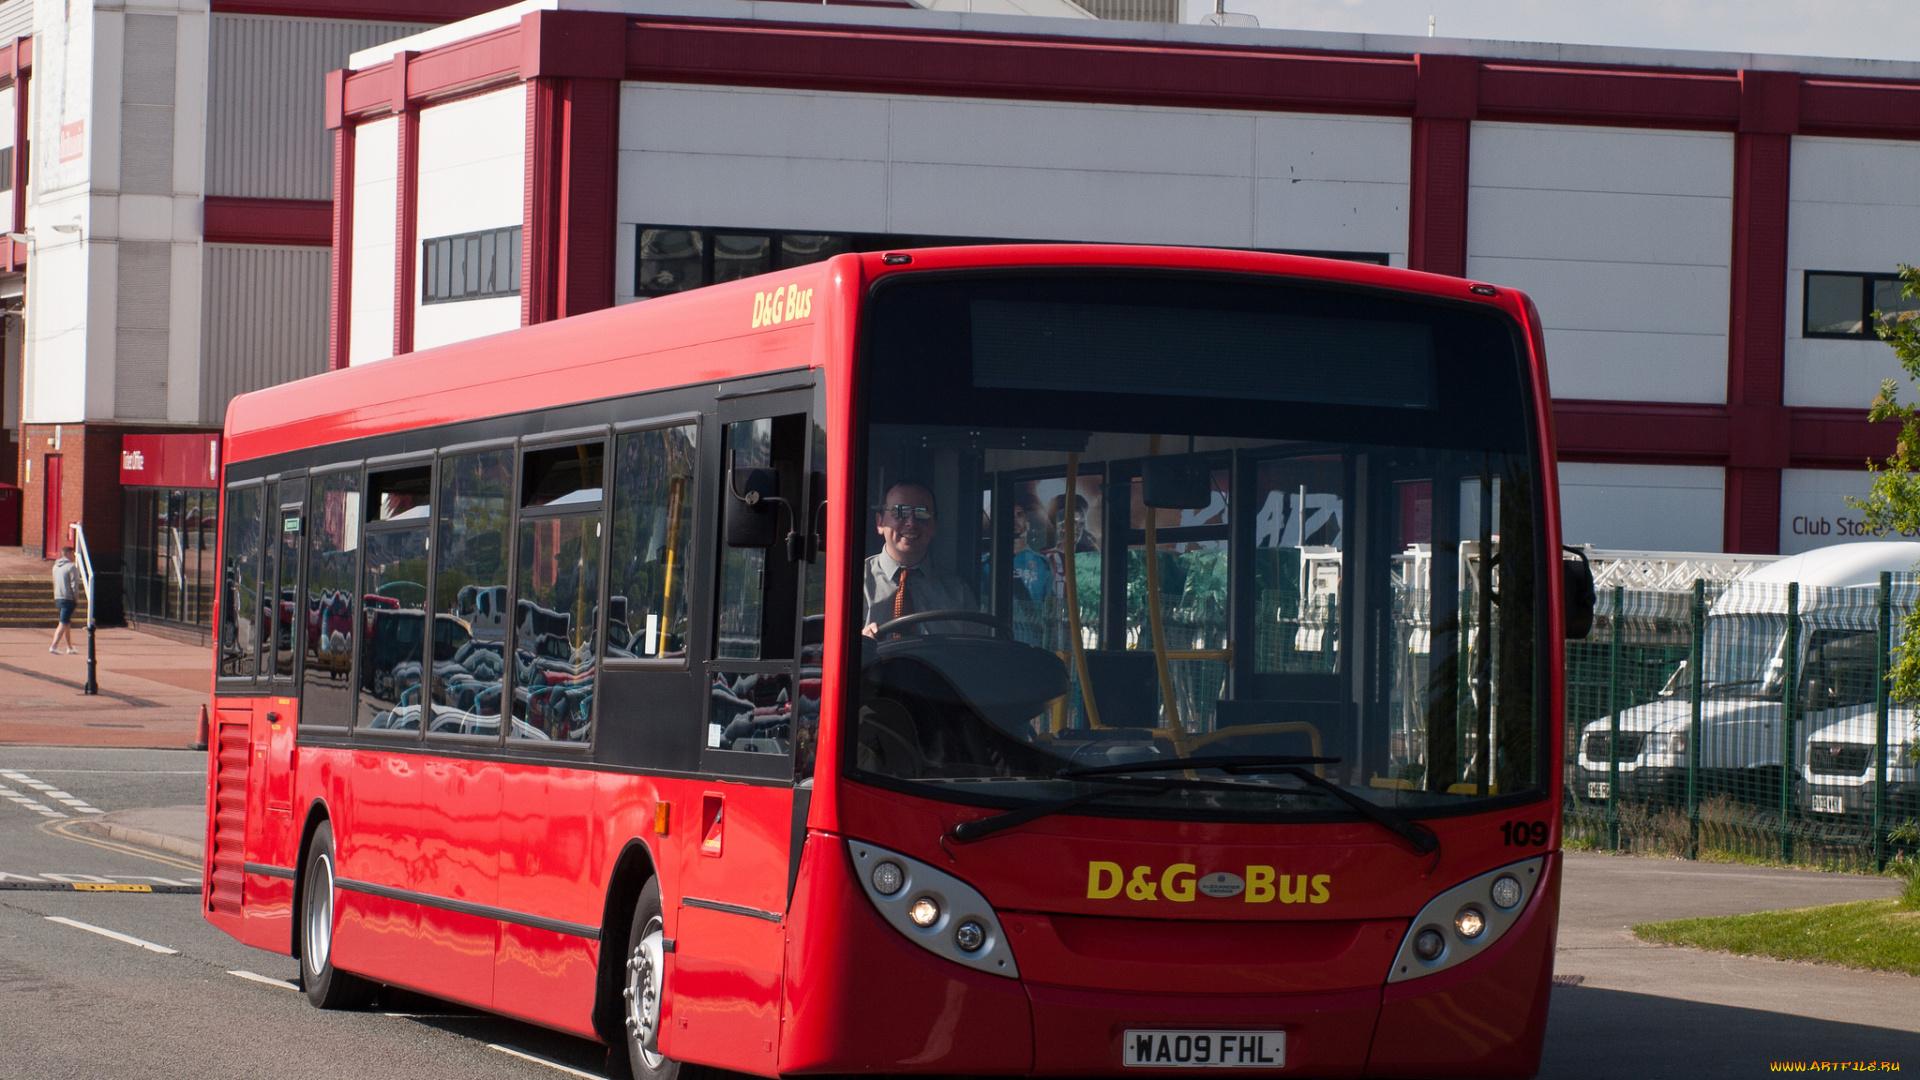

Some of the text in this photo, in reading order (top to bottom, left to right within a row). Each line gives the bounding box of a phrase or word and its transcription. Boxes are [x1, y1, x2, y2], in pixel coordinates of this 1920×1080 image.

[752, 283, 813, 329] D&G Bus
[1792, 516, 1831, 536] Club
[1500, 821, 1548, 847] 109
[1087, 861, 1331, 904] D&G Bus
[1136, 1034, 1274, 1063] WA09 FHL
